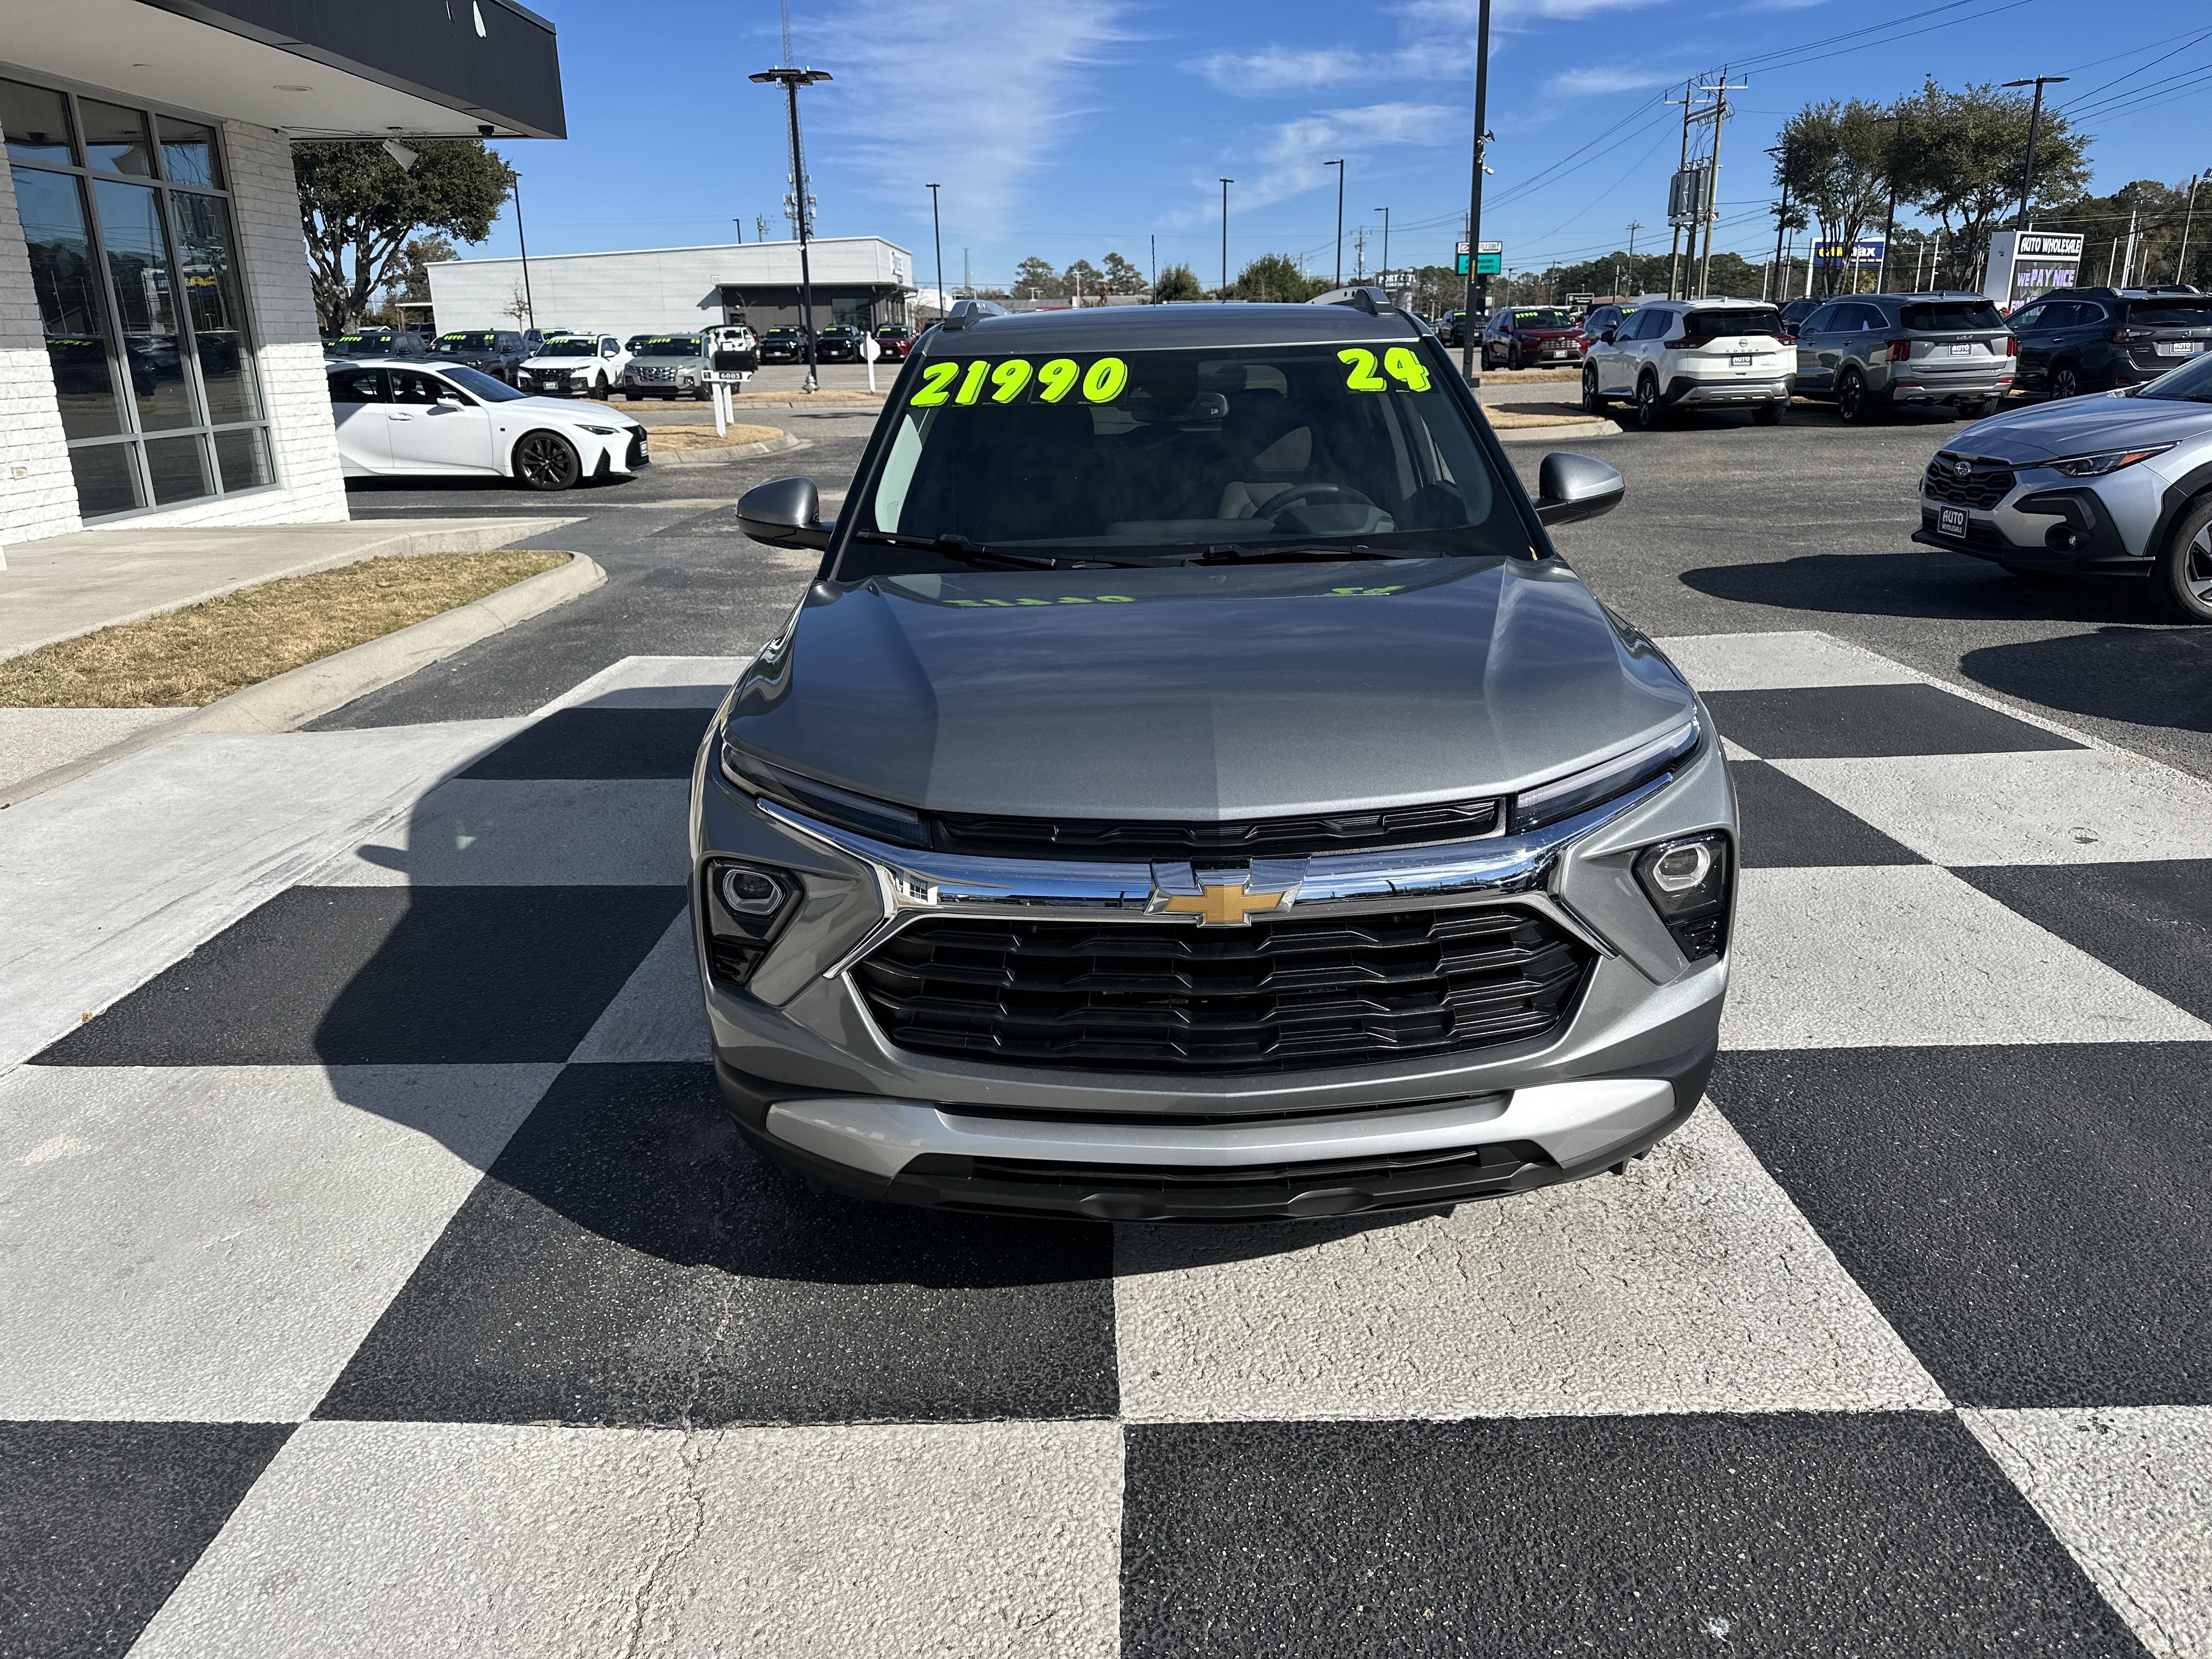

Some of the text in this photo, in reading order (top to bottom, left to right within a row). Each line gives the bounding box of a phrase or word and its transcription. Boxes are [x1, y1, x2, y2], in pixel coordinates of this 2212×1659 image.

[2021, 237, 2081, 254] AUTO WHOLESALE
[2017, 269, 2075, 287] WE PAY NICE
[910, 347, 1431, 408] 21990 24
[1942, 510, 1963, 525] AUTO
